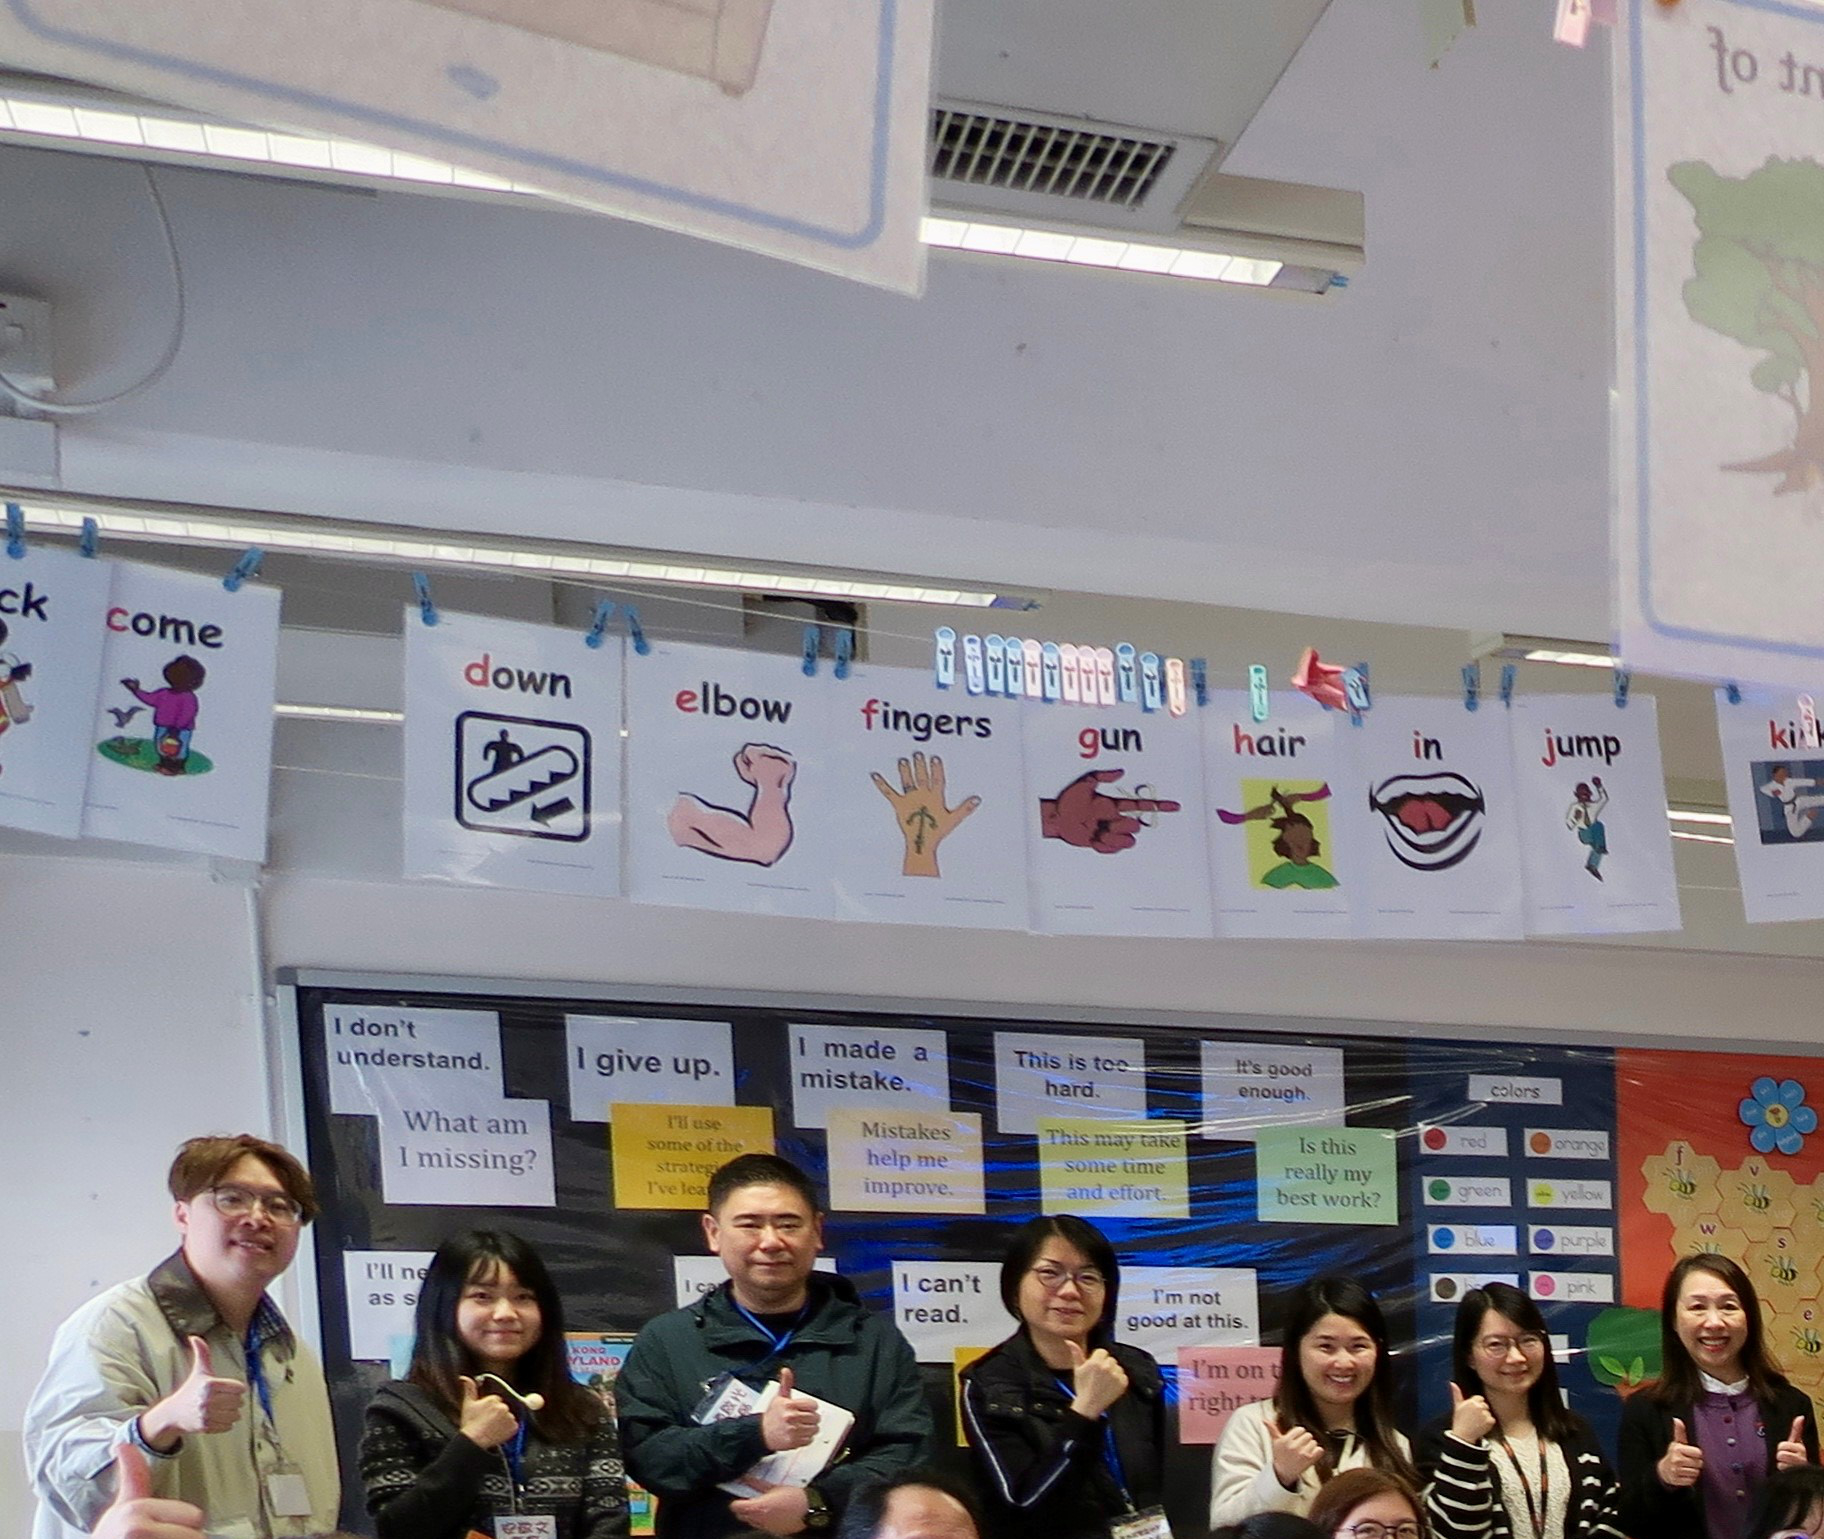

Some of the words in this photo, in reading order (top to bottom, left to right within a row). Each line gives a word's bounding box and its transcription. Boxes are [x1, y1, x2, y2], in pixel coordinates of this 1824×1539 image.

[0, 584, 48, 620] ck
[105, 605, 224, 649] come
[464, 653, 571, 700] down
[675, 684, 792, 724] elbow
[861, 696, 992, 743] fingers
[1078, 724, 1143, 760] gun
[1233, 723, 1306, 759] hair
[1413, 730, 1443, 761] in
[1541, 728, 1622, 766] jump
[333, 1017, 342, 1037] I
[350, 1018, 416, 1038] don't
[337, 1048, 491, 1072] understand.
[799, 1038, 807, 1058] I
[824, 1038, 896, 1060] made
[913, 1045, 928, 1061] a
[576, 1047, 585, 1071] I
[596, 1048, 662, 1080] give
[673, 1052, 721, 1084] up.
[1014, 1050, 1063, 1072] This
[1068, 1052, 1087, 1072] is
[1093, 1055, 1129, 1073] too
[1236, 1058, 1264, 1076] It's
[1269, 1062, 1313, 1083] good
[800, 1069, 912, 1093] mistake.
[1044, 1079, 1100, 1099] hard.
[1491, 1085, 1540, 1098] colors
[1238, 1082, 1312, 1105] enough.
[403, 1110, 478, 1134] What
[483, 1117, 529, 1135] am
[666, 1115, 688, 1131] I'll
[693, 1119, 721, 1132] use
[860, 1120, 951, 1141] Mistakes
[647, 1140, 687, 1154] some
[689, 1136, 706, 1153] of
[708, 1137, 743, 1153] the
[1046, 1129, 1088, 1148] This
[1093, 1133, 1128, 1155] may
[1134, 1130, 1181, 1150] take
[1299, 1137, 1315, 1155] Is
[1320, 1137, 1357, 1157] this
[1460, 1134, 1487, 1148] red
[1555, 1137, 1605, 1156] orange
[399, 1147, 408, 1168] I
[416, 1147, 537, 1176] missing?
[867, 1150, 910, 1172] help
[917, 1155, 949, 1170] me
[1064, 1159, 1113, 1176] some
[1120, 1157, 1165, 1176] time
[1284, 1163, 1342, 1187] really
[1346, 1168, 1373, 1187] my
[647, 1180, 677, 1196] I've
[864, 1177, 953, 1199] improve.
[1067, 1184, 1101, 1202] and
[1107, 1181, 1167, 1203] effort.
[1458, 1185, 1502, 1202] green
[1561, 1185, 1603, 1202] yellow
[1276, 1189, 1317, 1207] best
[1322, 1189, 1381, 1210] work?
[1464, 1231, 1495, 1248] blue
[1560, 1231, 1607, 1252] purple
[367, 1262, 394, 1280] I'll
[902, 1273, 908, 1294] I
[917, 1273, 980, 1295] can't
[1567, 1278, 1597, 1298] pink
[369, 1291, 394, 1306] as
[1153, 1289, 1185, 1307] I'm
[1190, 1290, 1221, 1308] not
[904, 1303, 968, 1325] read.
[1127, 1313, 1176, 1334] good
[1183, 1314, 1206, 1332] at
[1210, 1312, 1248, 1332] this.
[572, 1346, 607, 1355] KONG
[1192, 1359, 1230, 1380] I'm
[1236, 1366, 1264, 1381] on
[1189, 1389, 1242, 1416] right
